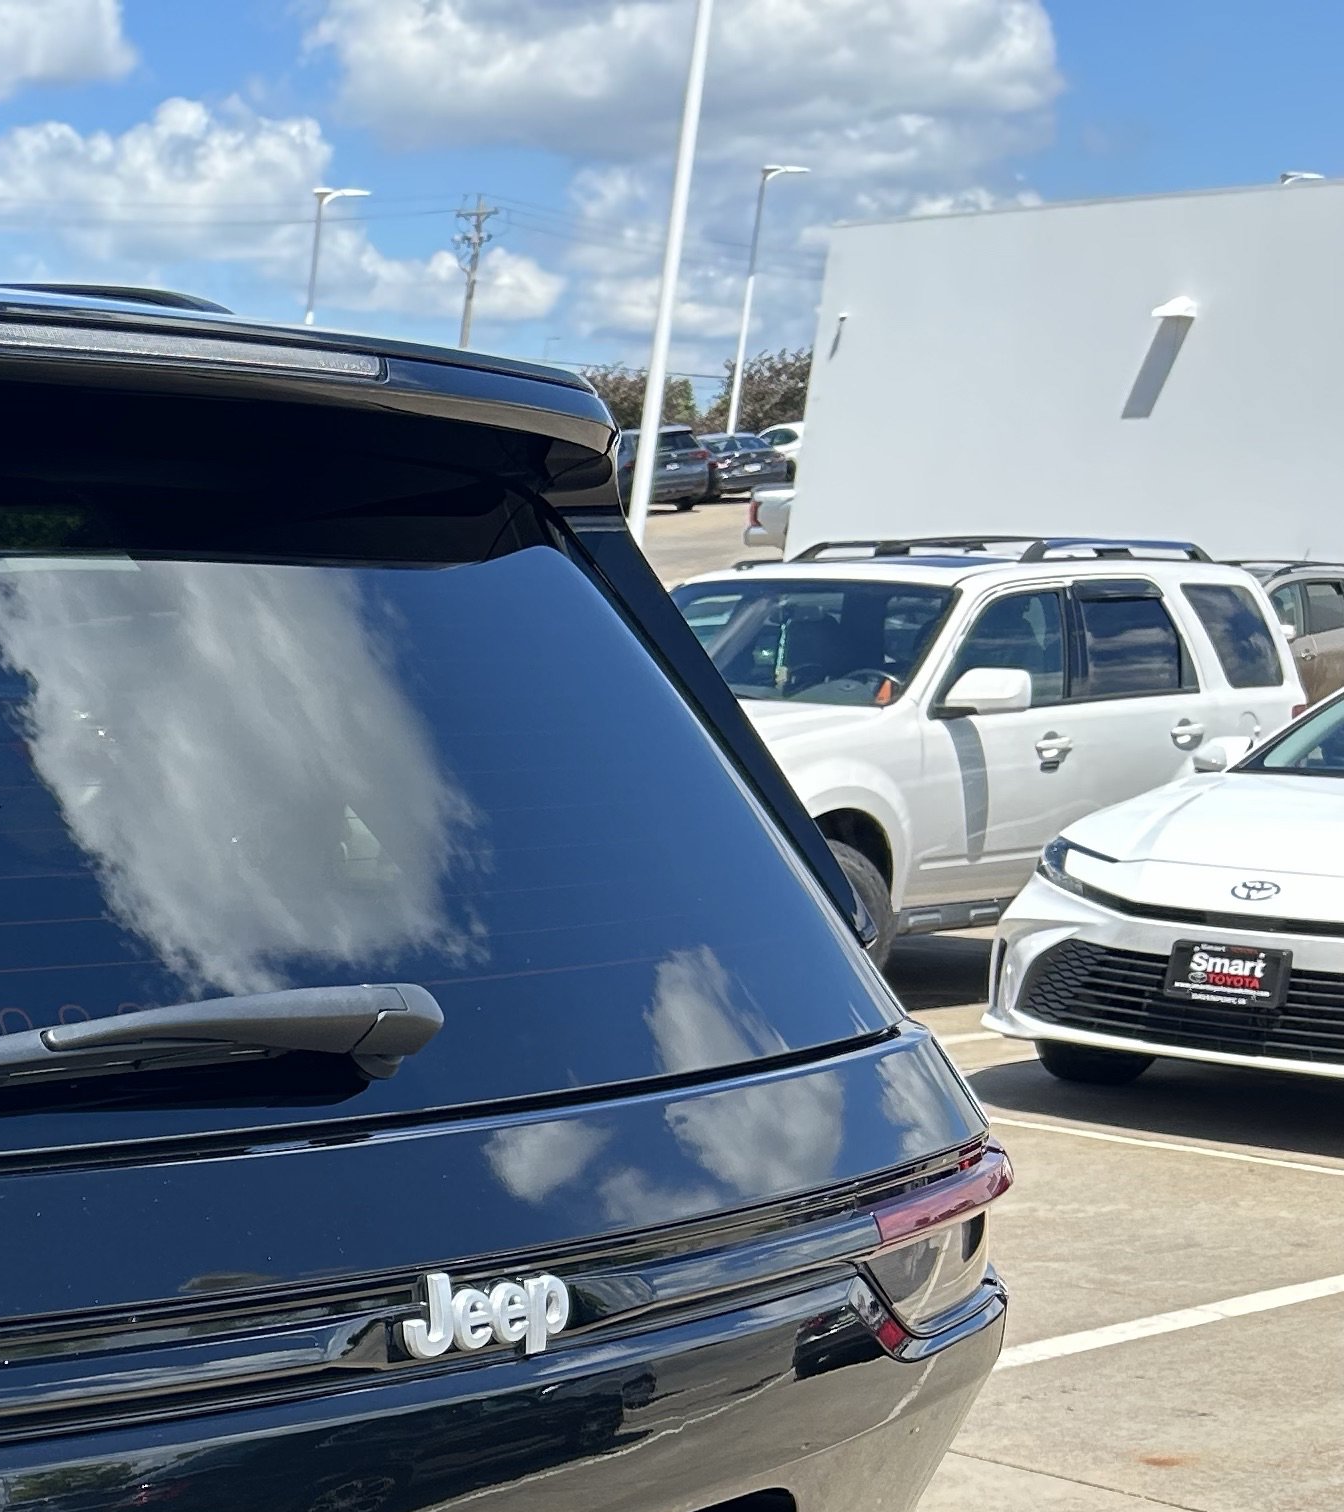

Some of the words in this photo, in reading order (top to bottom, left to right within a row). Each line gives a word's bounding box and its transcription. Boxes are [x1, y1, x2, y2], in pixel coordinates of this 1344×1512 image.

[1190, 951, 1266, 978] Smart
[1207, 973, 1260, 989] TOYOTA
[403, 1272, 570, 1358] Jeep
